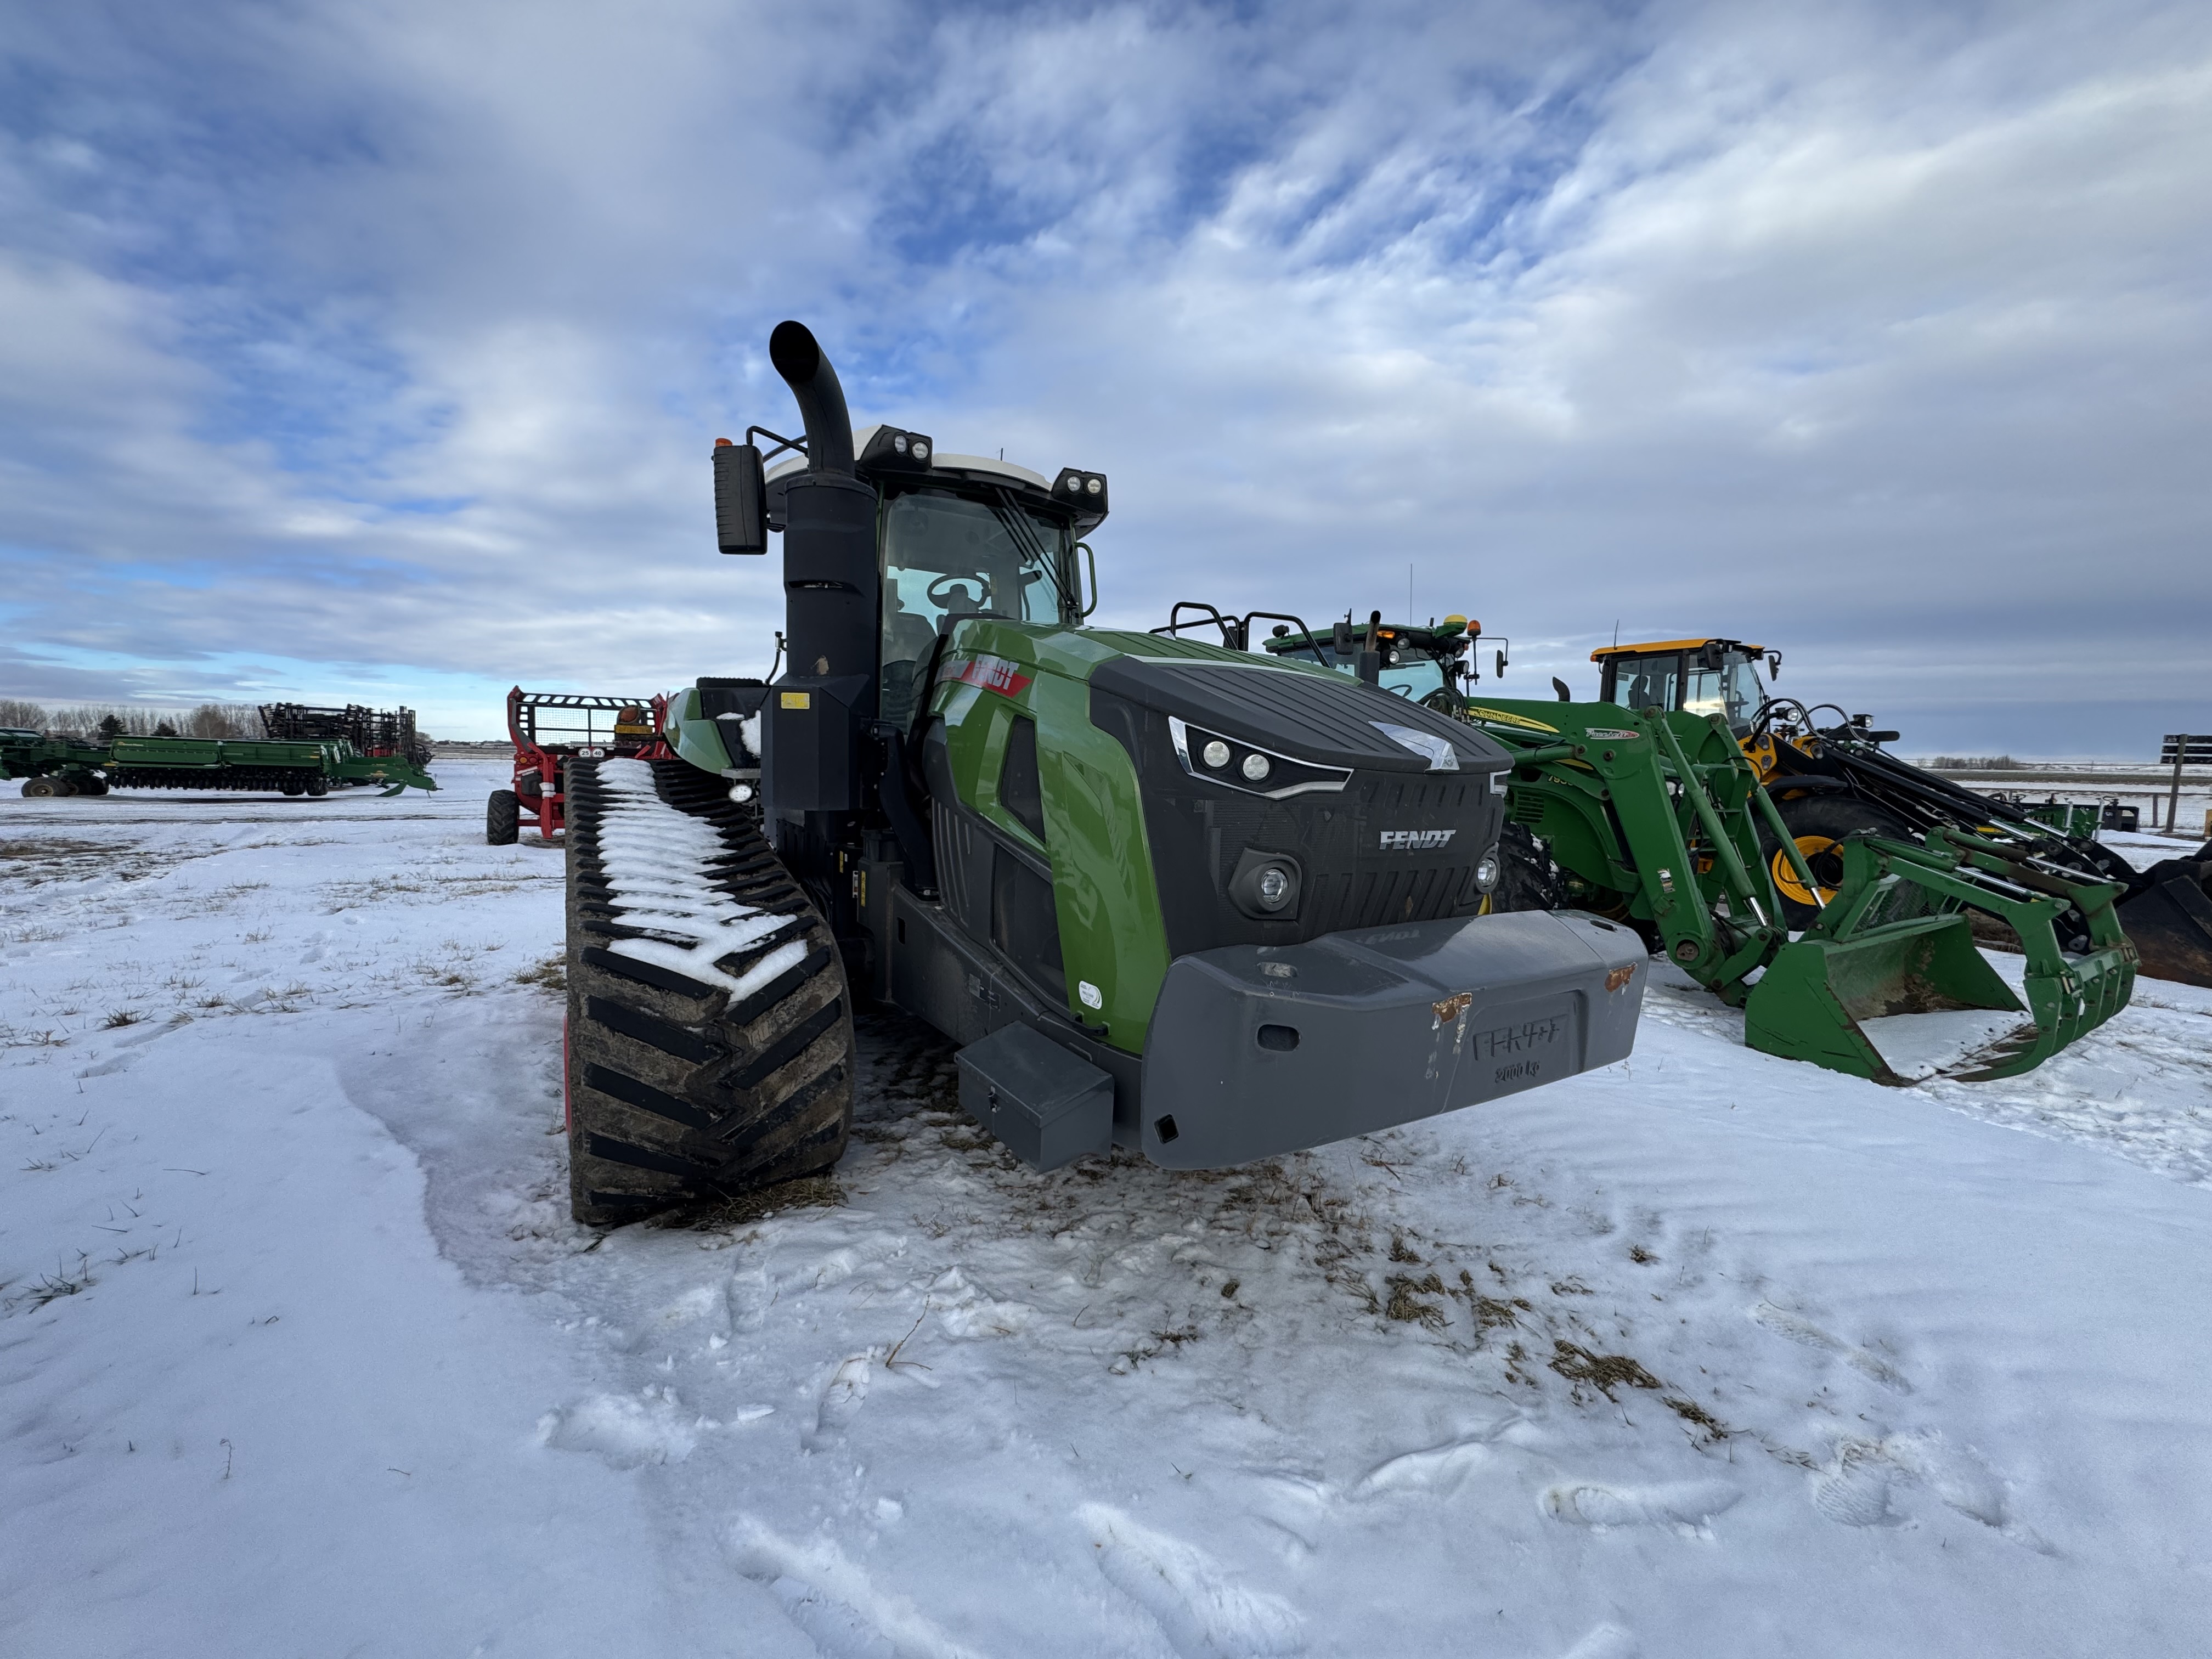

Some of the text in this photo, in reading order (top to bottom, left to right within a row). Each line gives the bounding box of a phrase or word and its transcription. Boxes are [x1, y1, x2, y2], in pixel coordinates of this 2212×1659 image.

[972, 653, 1020, 690] FENDT
[1497, 713, 1520, 724] DEERE
[1379, 829, 1457, 850] FENDT
